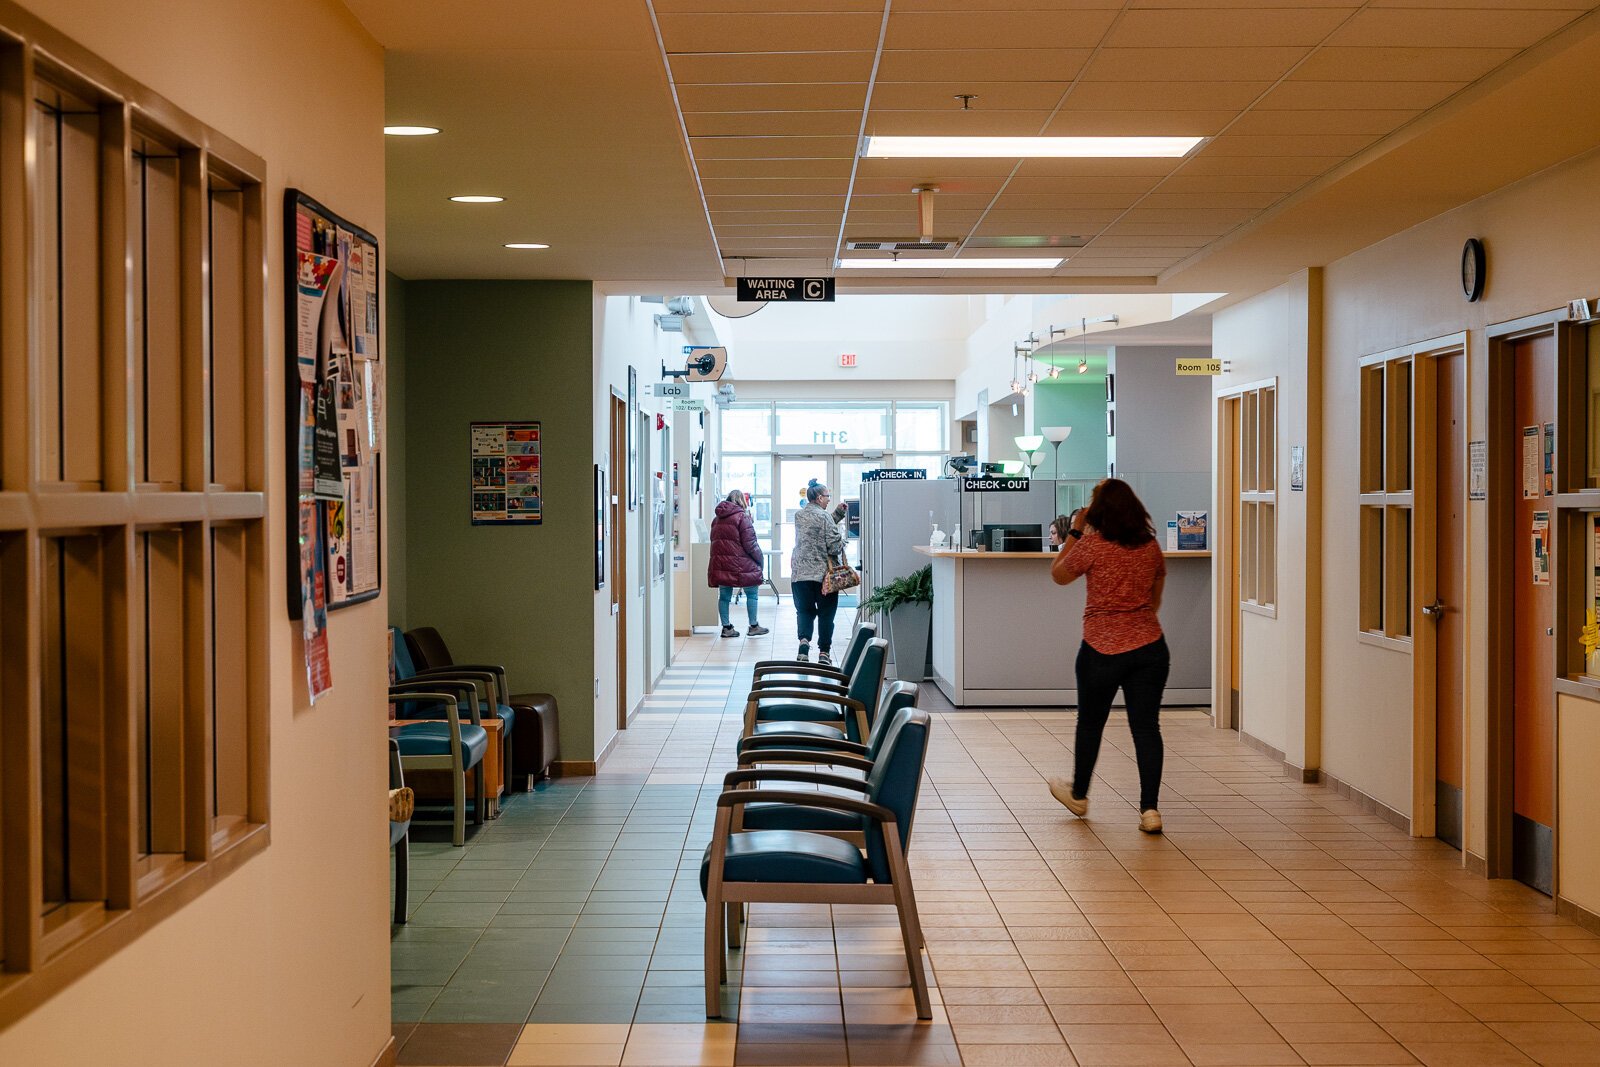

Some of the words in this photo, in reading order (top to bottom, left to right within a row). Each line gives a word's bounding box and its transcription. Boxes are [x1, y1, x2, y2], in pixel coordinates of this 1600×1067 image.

[747, 279, 795, 289] WAITING
[807, 281, 821, 297] C
[755, 290, 788, 299] AREA
[841, 354, 856, 366] EXIT
[663, 386, 682, 395] Lab
[879, 471, 908, 479] CHECK
[914, 471, 923, 479] IN
[965, 480, 1000, 489] CHECK
[1007, 480, 1029, 489] OUT
